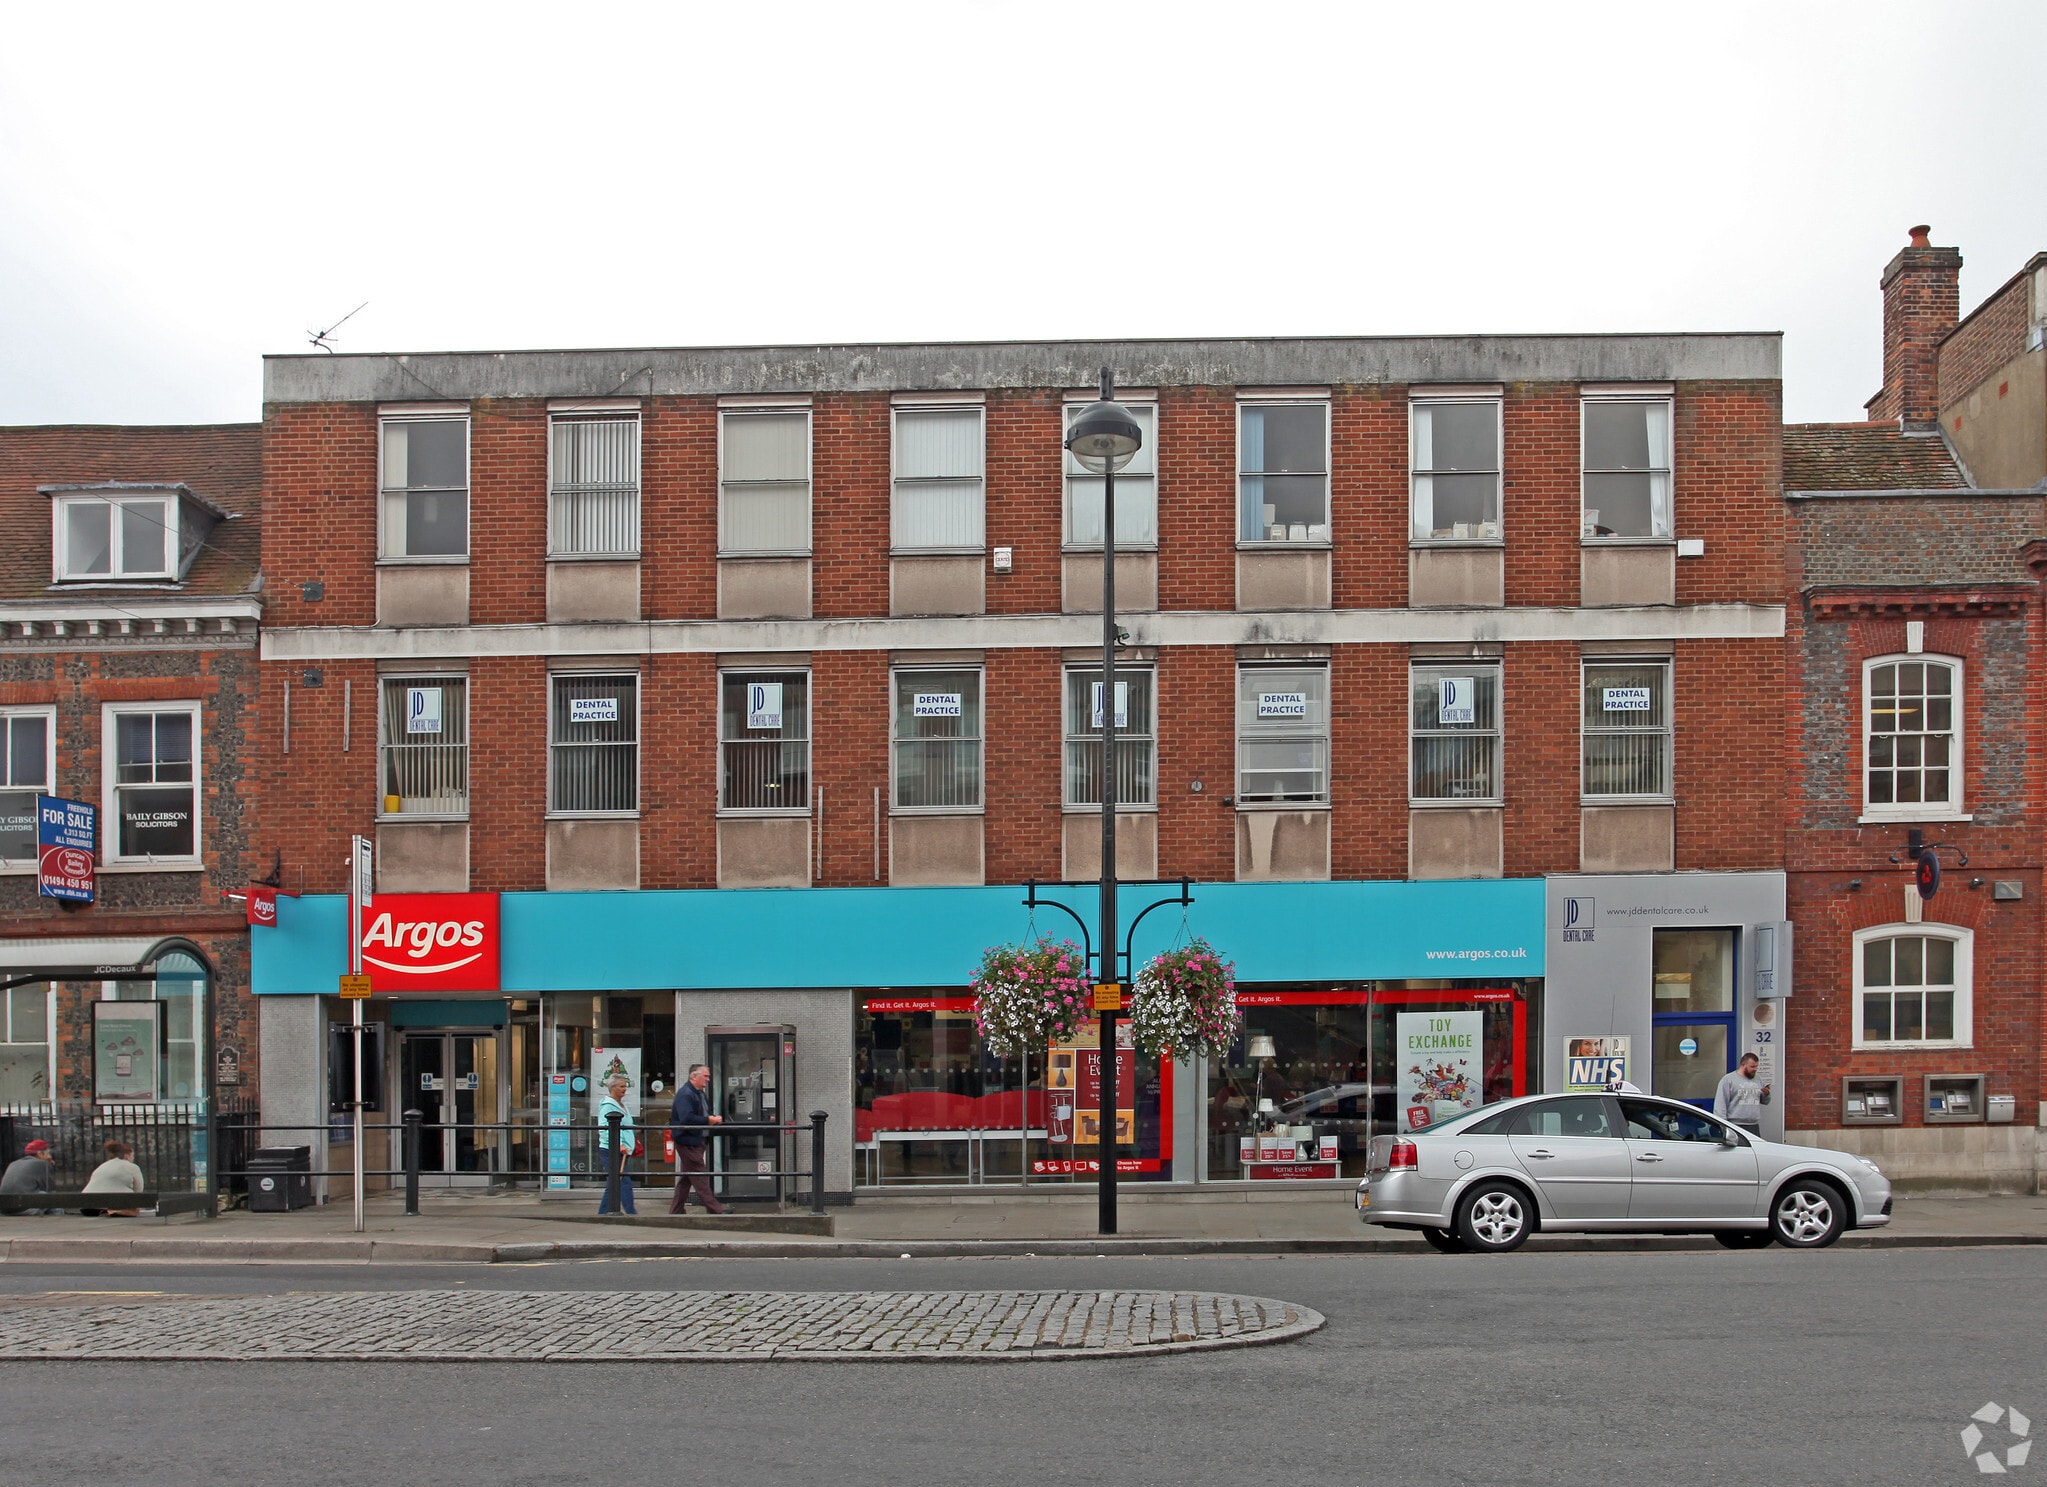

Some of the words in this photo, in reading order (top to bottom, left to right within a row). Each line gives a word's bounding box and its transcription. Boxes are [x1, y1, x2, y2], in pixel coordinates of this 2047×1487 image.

[752, 686, 764, 714] JD
[1443, 681, 1456, 709] JD
[412, 692, 424, 720] JD
[1260, 706, 1304, 714] PRACTICE
[572, 712, 616, 720] PRACTICE
[750, 714, 767, 726] DENTAL
[768, 714, 780, 726] CARE
[1442, 710, 1459, 721] DENTAL
[1460, 710, 1472, 720] CARE
[410, 720, 426, 731] DENTAL
[428, 720, 439, 731] CARE
[67, 804, 94, 816] FREEHOLD
[126, 812, 152, 820] BAILY
[152, 812, 188, 820] GIBSON
[43, 808, 64, 826] FOR
[68, 813, 92, 830] SALE
[55, 836, 66, 844] ALL
[66, 837, 93, 848] ENQUIRIES
[65, 852, 86, 861] Duncan
[68, 858, 84, 868] Bailey
[64, 864, 86, 876] Kennedy
[44, 874, 65, 886] 01494
[67, 878, 80, 888] 450
[254, 897, 275, 915] Argos
[1606, 906, 1709, 917] www.jddentalcare.co.uk
[1565, 899, 1578, 928] JD
[362, 912, 484, 958] Argos
[1563, 930, 1581, 942] DENTAL
[1582, 930, 1594, 942] CARE
[1426, 948, 1527, 961] www.argos.co.uk
[94, 965, 136, 974] JCDecaux
[1428, 1018, 1452, 1032] TOY
[1408, 1034, 1472, 1048] EXCHANGE
[1756, 1032, 1771, 1042] 32
[1088, 1054, 1123, 1064] Hoe
[1090, 1064, 1121, 1076] Evt
[1571, 1059, 1624, 1083] NHS
[728, 1076, 750, 1087] BT
